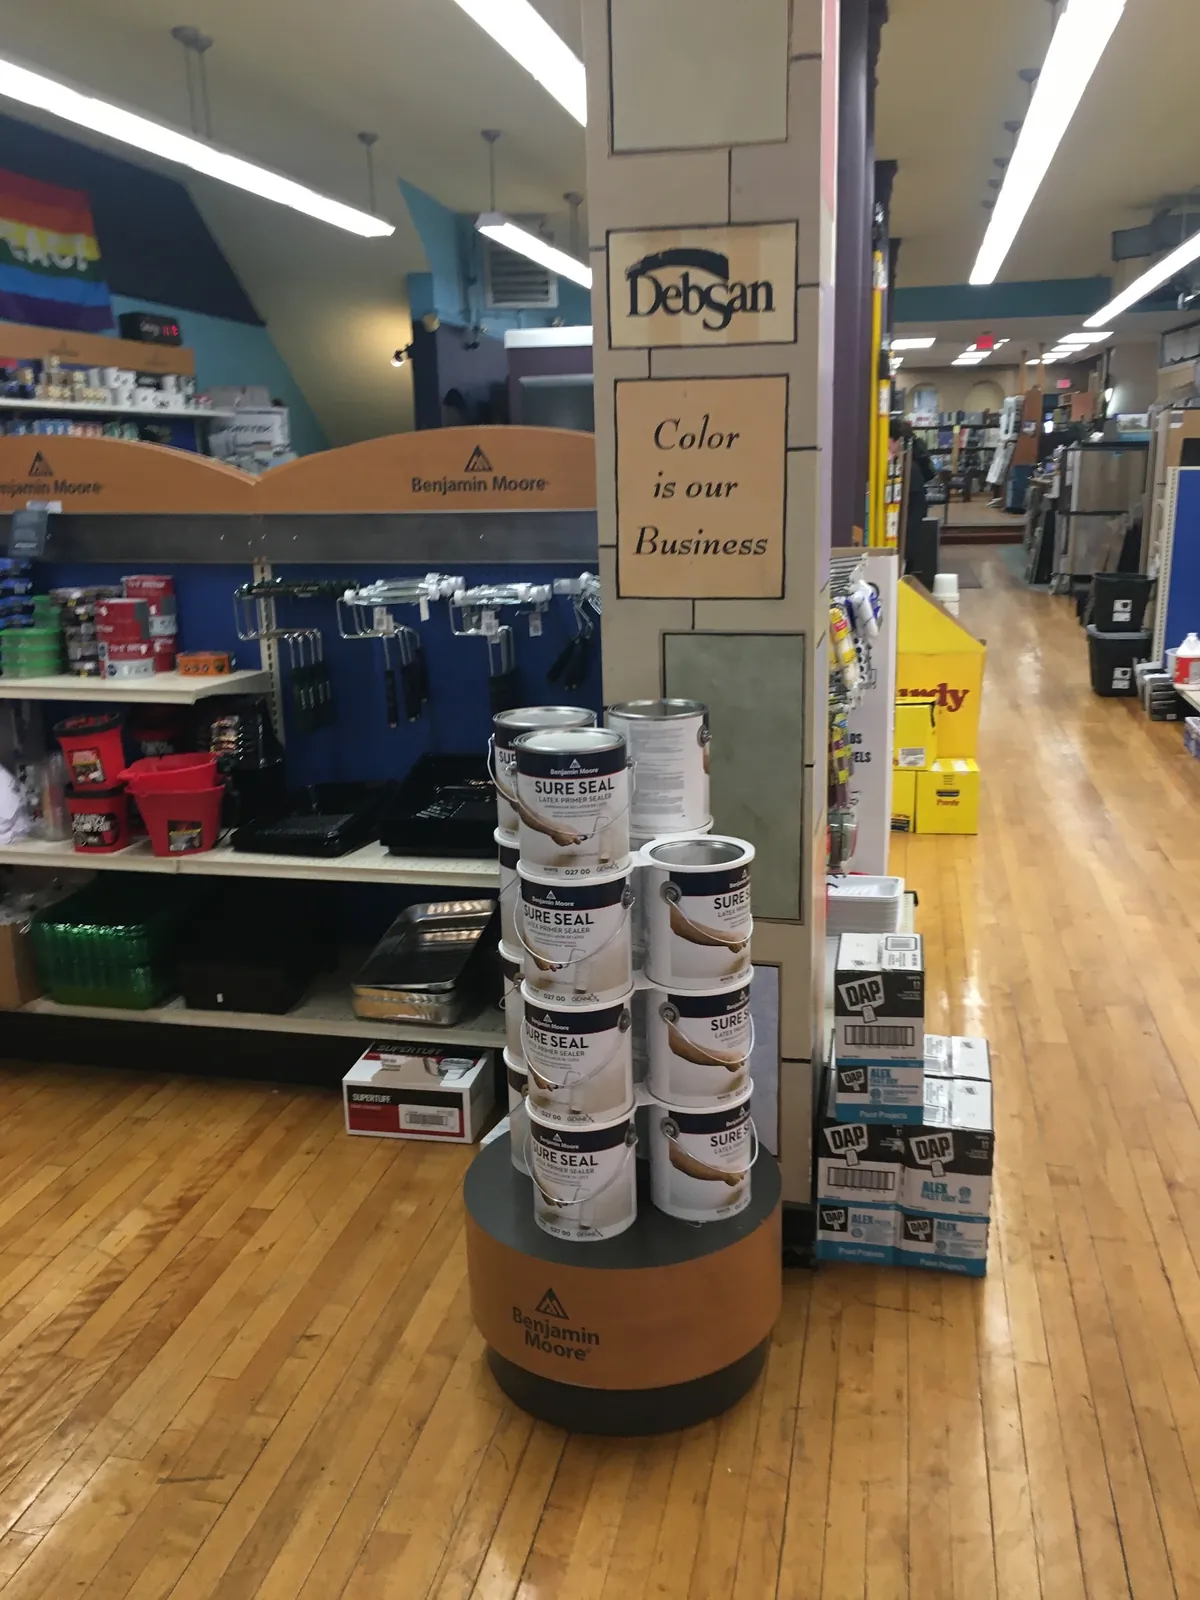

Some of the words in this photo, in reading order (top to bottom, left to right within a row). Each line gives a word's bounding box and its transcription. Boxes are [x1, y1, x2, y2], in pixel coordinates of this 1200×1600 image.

[653, 414, 740, 452] Color
[411, 475, 488, 497] Benjamin
[492, 475, 546, 493] Moore
[653, 470, 676, 499] is
[685, 478, 738, 499] our
[634, 525, 769, 556] Business
[550, 768, 578, 777] Benjamin
[535, 780, 576, 795] SURE
[579, 778, 615, 794] SEAL
[539, 796, 560, 804] LATEX
[561, 795, 588, 804] PRIMER
[589, 793, 612, 803] SEALER
[580, 868, 591, 876] 00
[713, 894, 744, 910] SURE
[554, 912, 594, 926] SEAL
[845, 980, 881, 1007] DAP
[710, 1014, 741, 1030] SURE
[550, 1036, 589, 1049] SEAL
[352, 1093, 392, 1104] SUPERTUFF
[710, 1130, 741, 1147] SURE
[830, 1126, 863, 1150] DAP
[915, 1136, 950, 1160] DAP
[559, 1153, 599, 1167] SEAL
[921, 1181, 948, 1194] ALEX
[512, 1305, 600, 1346] Benjamin
[524, 1328, 587, 1362] Moore
